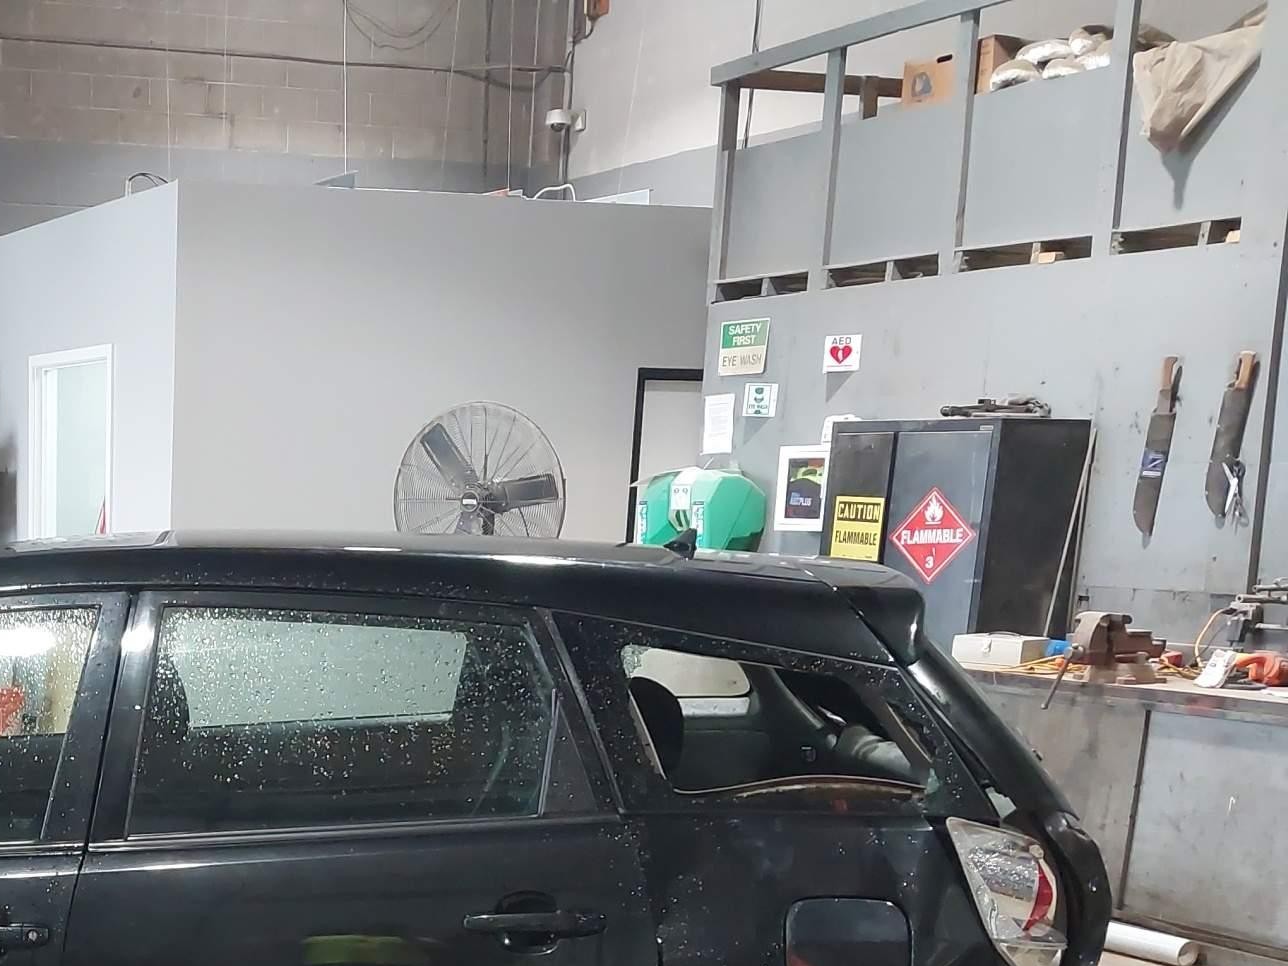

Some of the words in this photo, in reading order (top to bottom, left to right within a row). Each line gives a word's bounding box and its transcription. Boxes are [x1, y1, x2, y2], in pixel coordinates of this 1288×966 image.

[728, 323, 762, 336] SAFETY
[732, 335, 757, 346] FIRST
[831, 336, 852, 346] AED
[722, 355, 737, 367] EYE
[740, 353, 762, 367] WASH
[838, 502, 880, 521] CAUTION
[835, 530, 877, 546] FLAMMABLE
[901, 528, 963, 545] FLAMMABLE
[925, 556, 933, 569] 3
